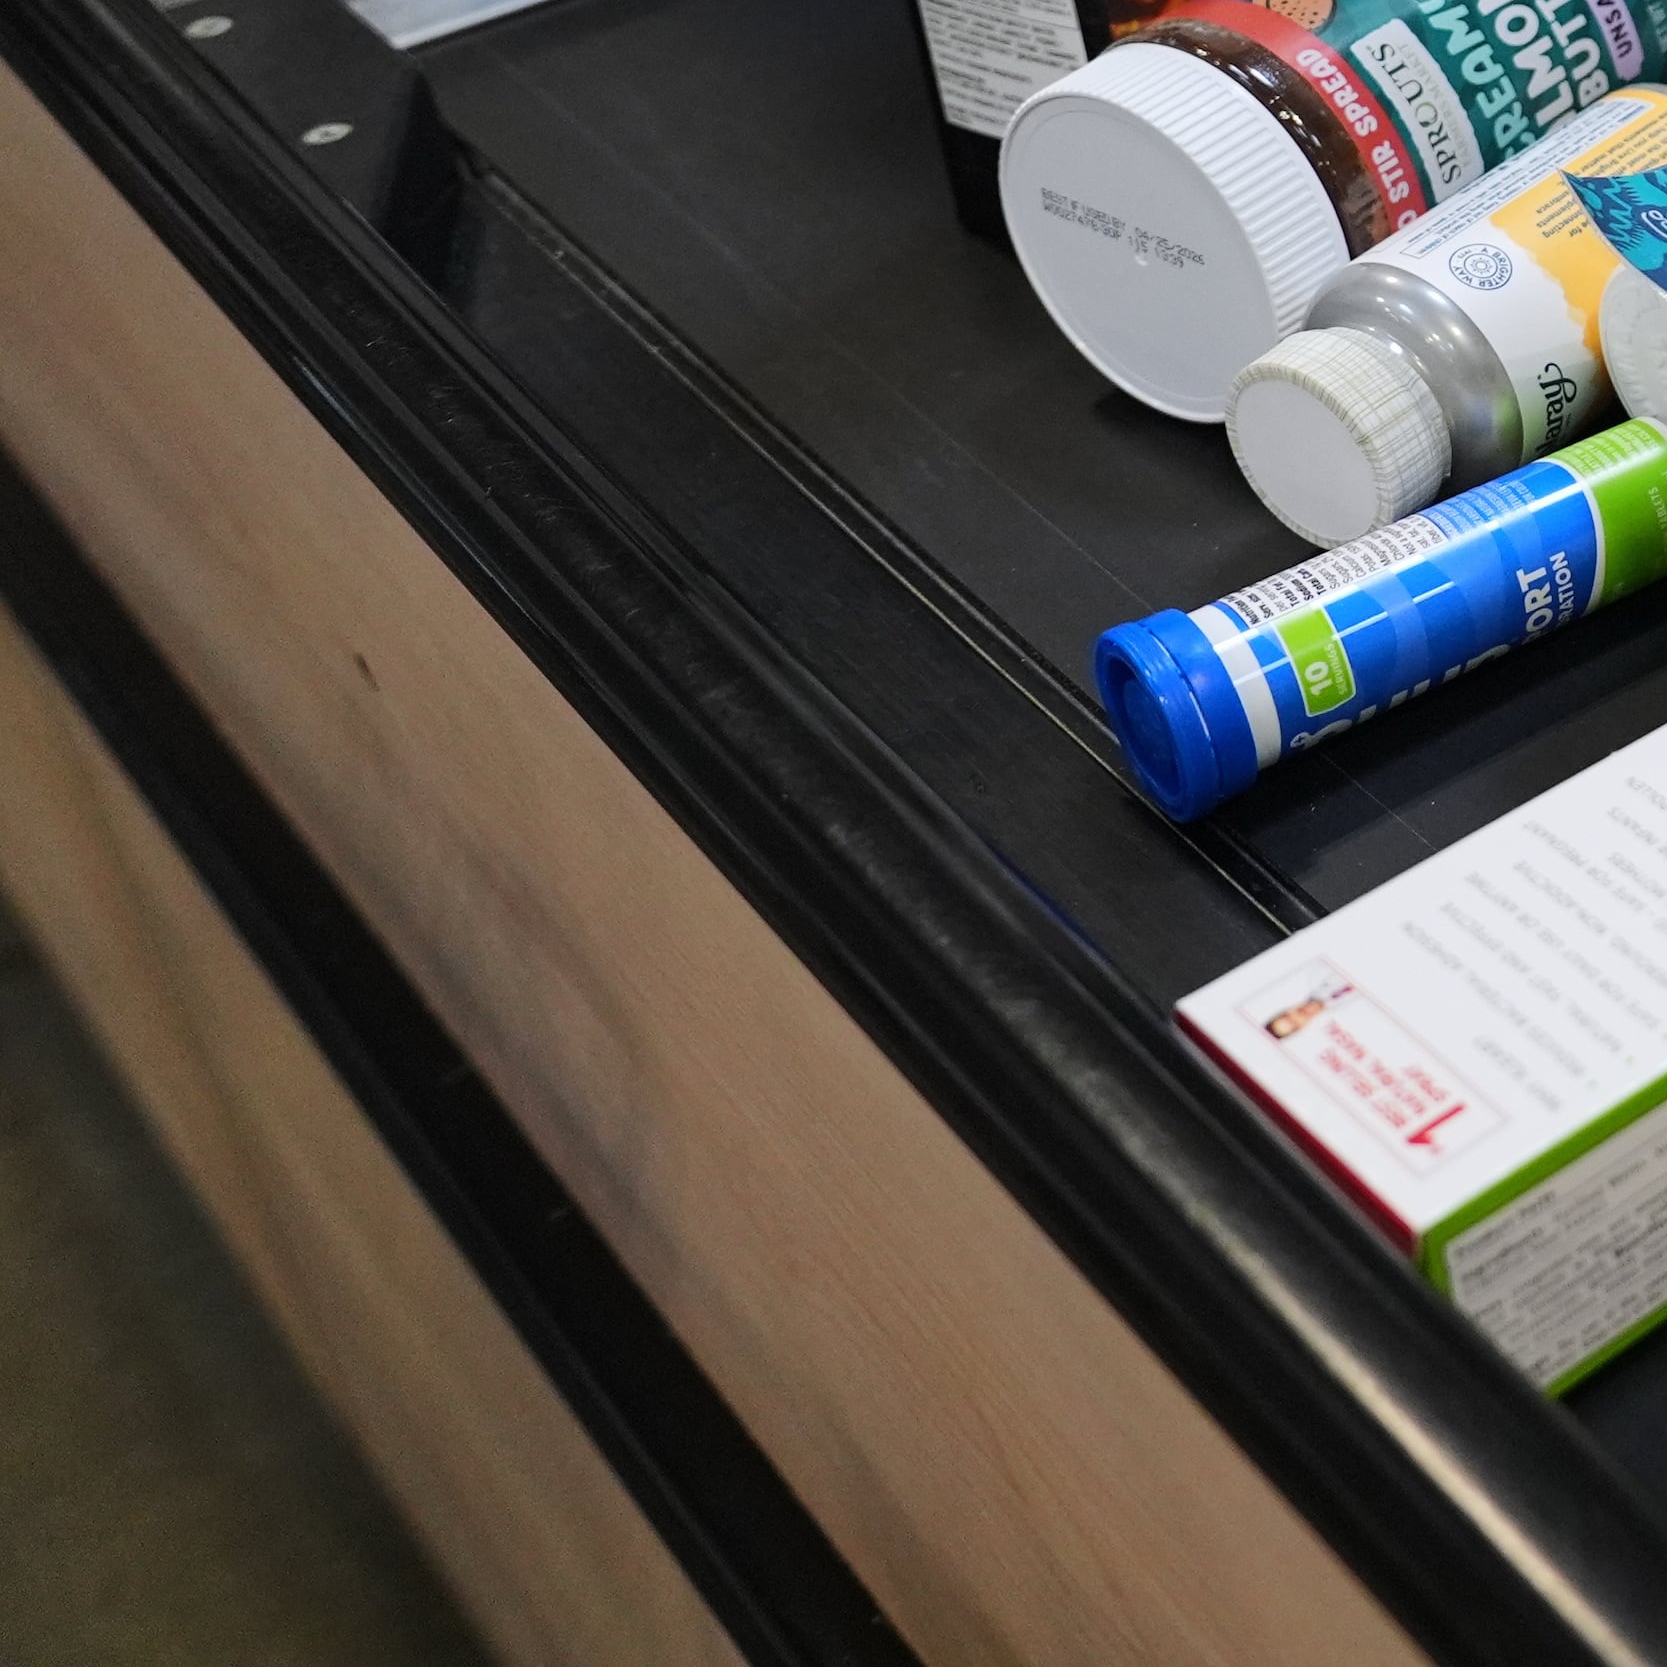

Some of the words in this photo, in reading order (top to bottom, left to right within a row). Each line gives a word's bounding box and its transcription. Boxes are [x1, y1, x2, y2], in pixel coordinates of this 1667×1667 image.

[1296, 48, 1379, 137] SPREAD
[1371, 43, 1461, 184] SPROUTS
[1371, 140, 1410, 203] STIR
[1286, 590, 1301, 608] Total
[1291, 579, 1314, 601] Sodium
[1312, 578, 1328, 595] Total
[1516, 567, 1553, 637] ORT
[1304, 660, 1333, 696] 10
[1404, 1088, 1466, 1158] 1
